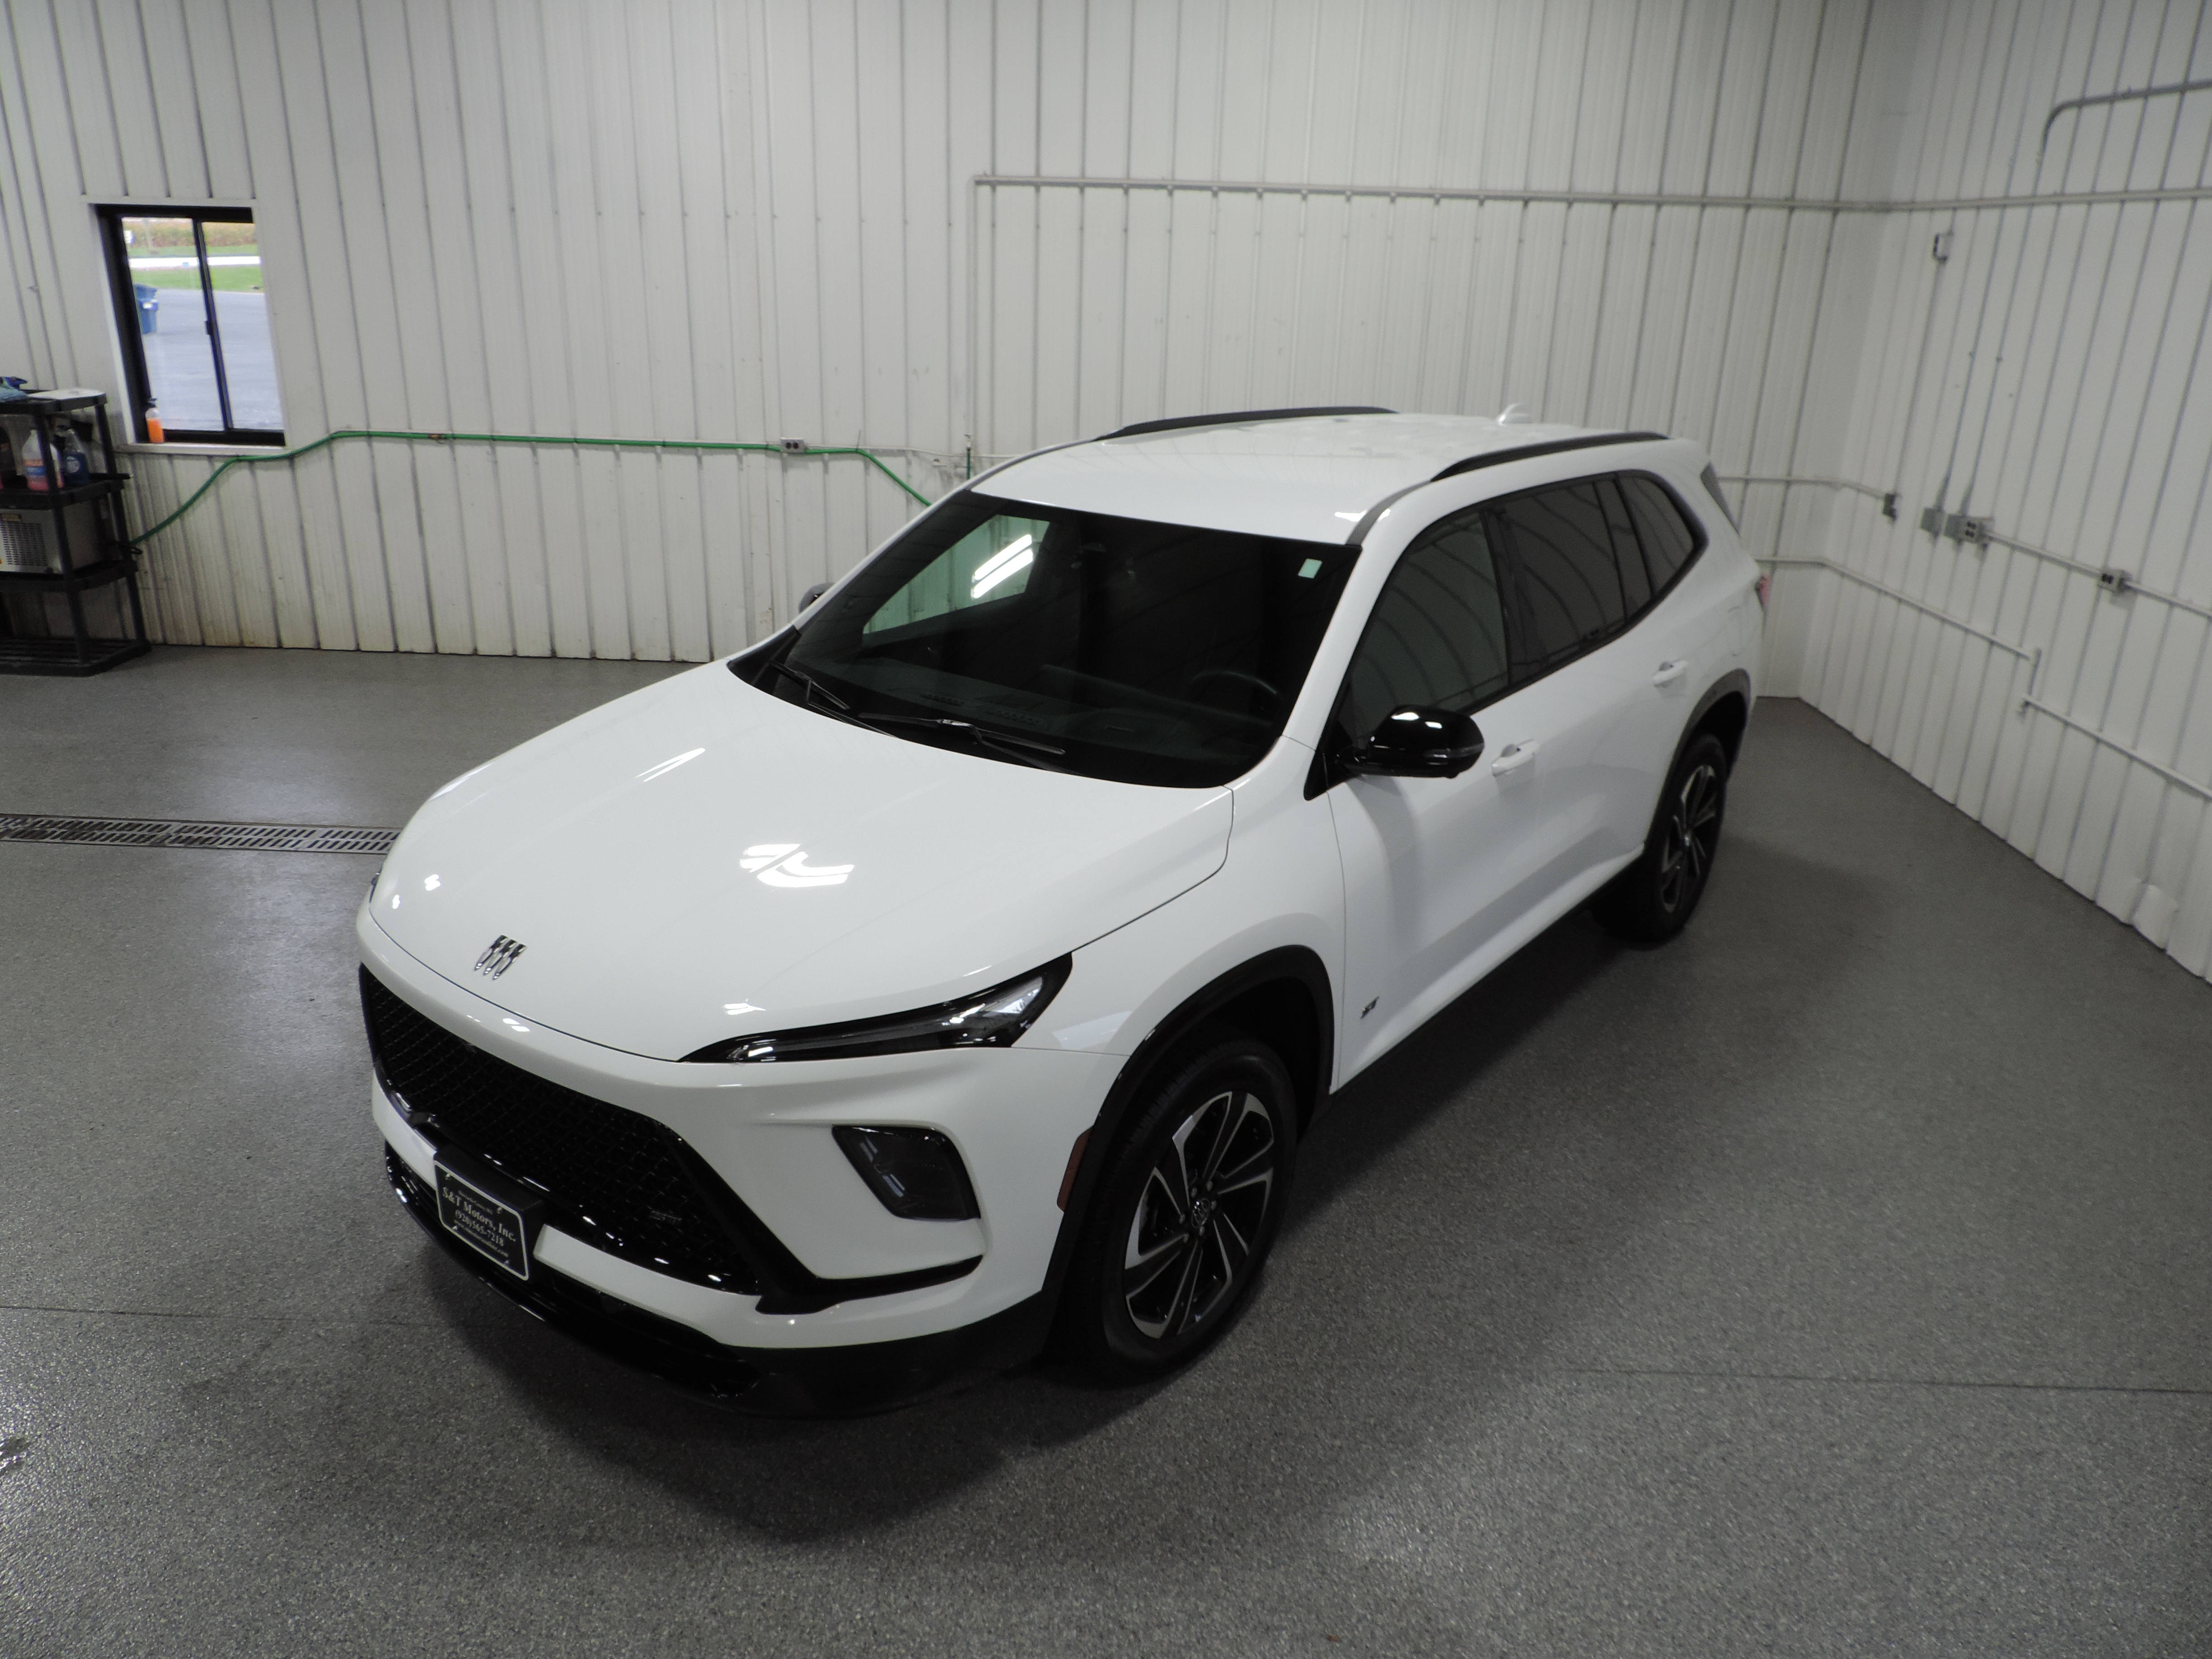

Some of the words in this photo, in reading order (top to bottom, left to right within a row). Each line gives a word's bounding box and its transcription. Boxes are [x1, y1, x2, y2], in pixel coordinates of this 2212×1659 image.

[443, 1186, 461, 1206] S&T
[464, 1201, 496, 1231] Motors,
[498, 1223, 516, 1242] Inc.
